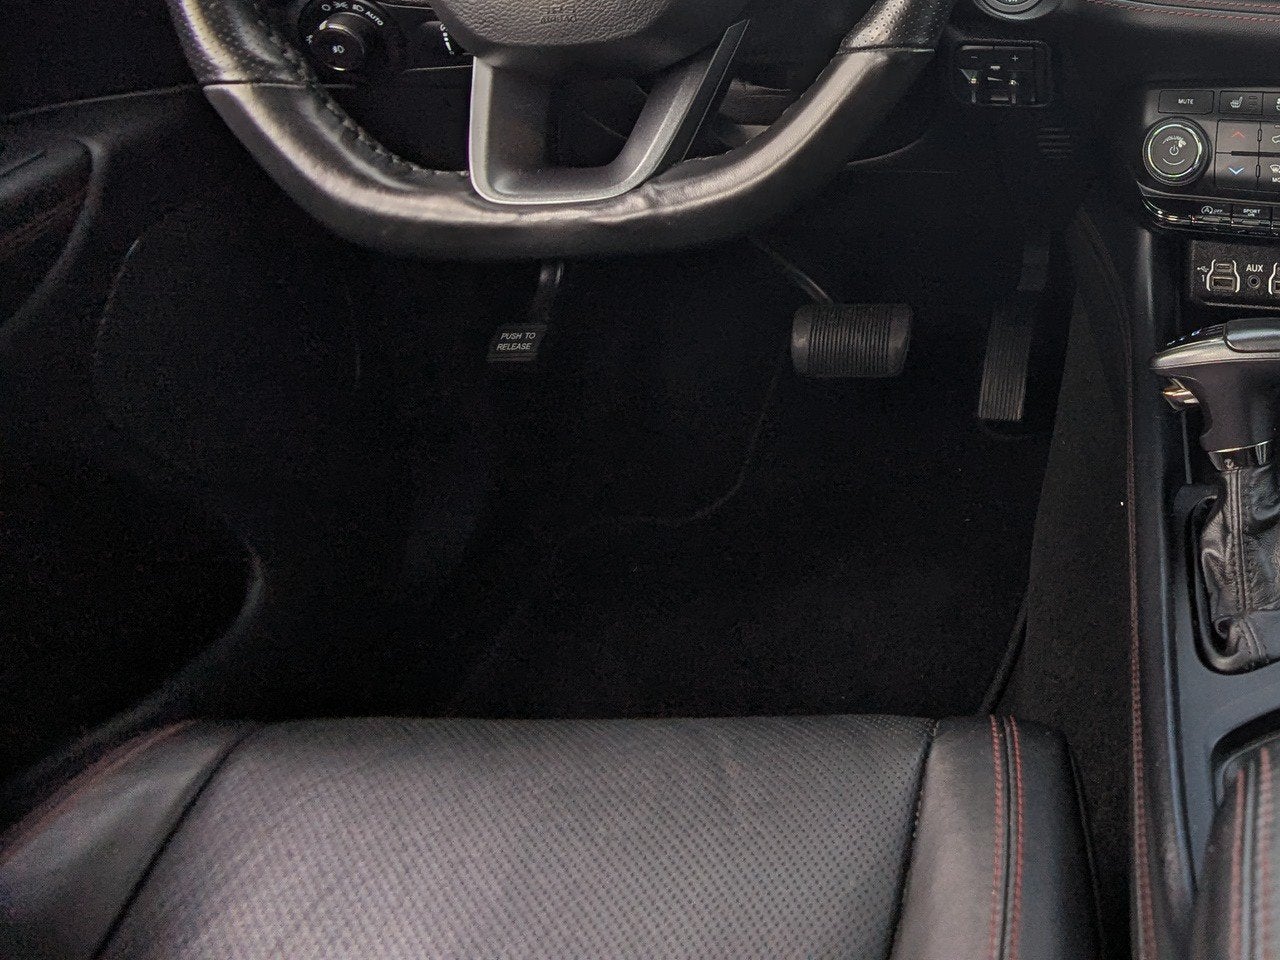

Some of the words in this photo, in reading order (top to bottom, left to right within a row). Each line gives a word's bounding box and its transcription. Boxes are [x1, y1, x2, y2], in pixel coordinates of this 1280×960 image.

[365, 11, 384, 26] AUTO
[1246, 264, 1264, 273] AUX
[500, 332, 523, 340] PUSH
[525, 332, 536, 340] TO
[496, 342, 532, 350] RELEASE
